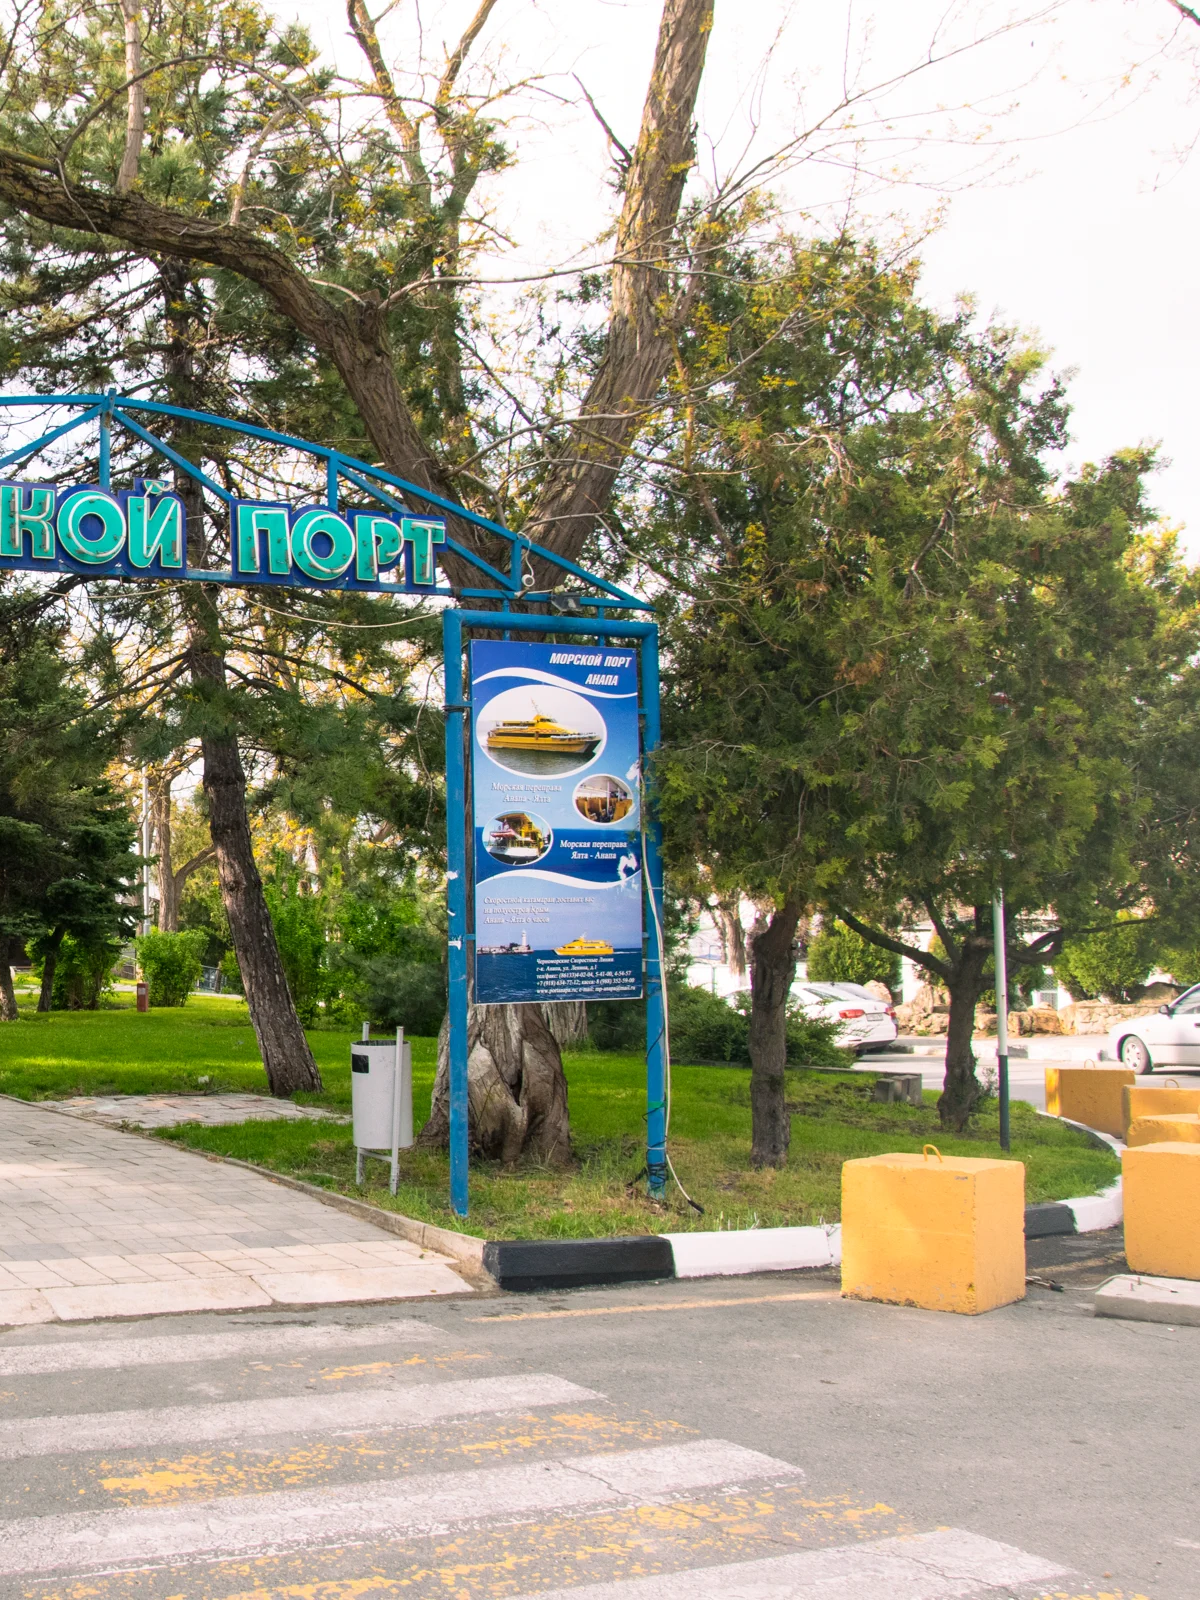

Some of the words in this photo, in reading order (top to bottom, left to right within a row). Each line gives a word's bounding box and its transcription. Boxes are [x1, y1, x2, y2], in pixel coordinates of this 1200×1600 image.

[237, 503, 446, 586] ПОРТ
[549, 653, 602, 666] МОРСКОЙ
[604, 656, 632, 668] ПОРТ
[585, 674, 618, 686] АНАПА
[491, 782, 524, 792] Морская
[525, 784, 562, 793] переправа
[532, 795, 551, 803] Ялта
[560, 840, 591, 849] Морская
[571, 851, 588, 859] Ялта
[595, 851, 616, 859] Анапа
